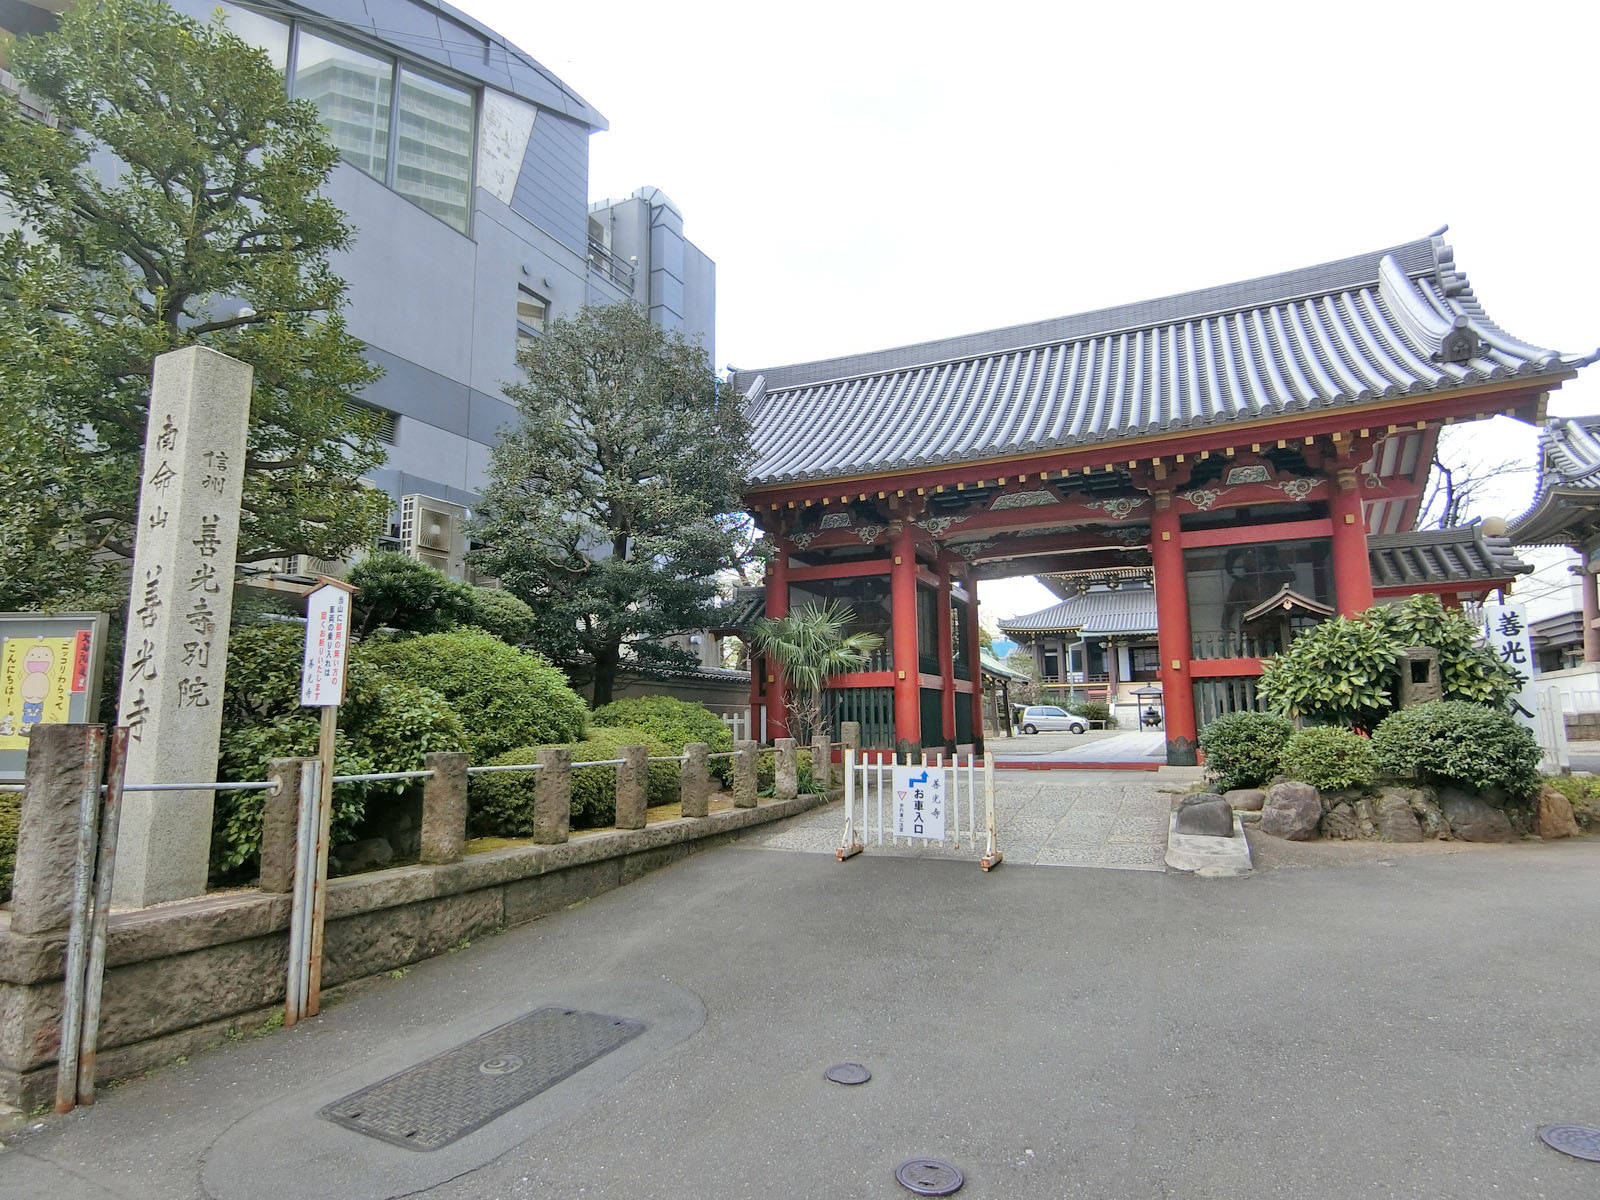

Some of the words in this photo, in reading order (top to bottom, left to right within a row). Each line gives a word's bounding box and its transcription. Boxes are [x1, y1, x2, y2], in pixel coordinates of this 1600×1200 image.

[150, 414, 179, 528] 南命山
[201, 450, 229, 495] 信州
[126, 565, 163, 742] 善光寺
[178, 514, 222, 709] 善光寺別院
[55, 643, 70, 711] ニッコリわらって
[1496, 611, 1535, 736] 善光寺入
[914, 788, 924, 834] お車入口
